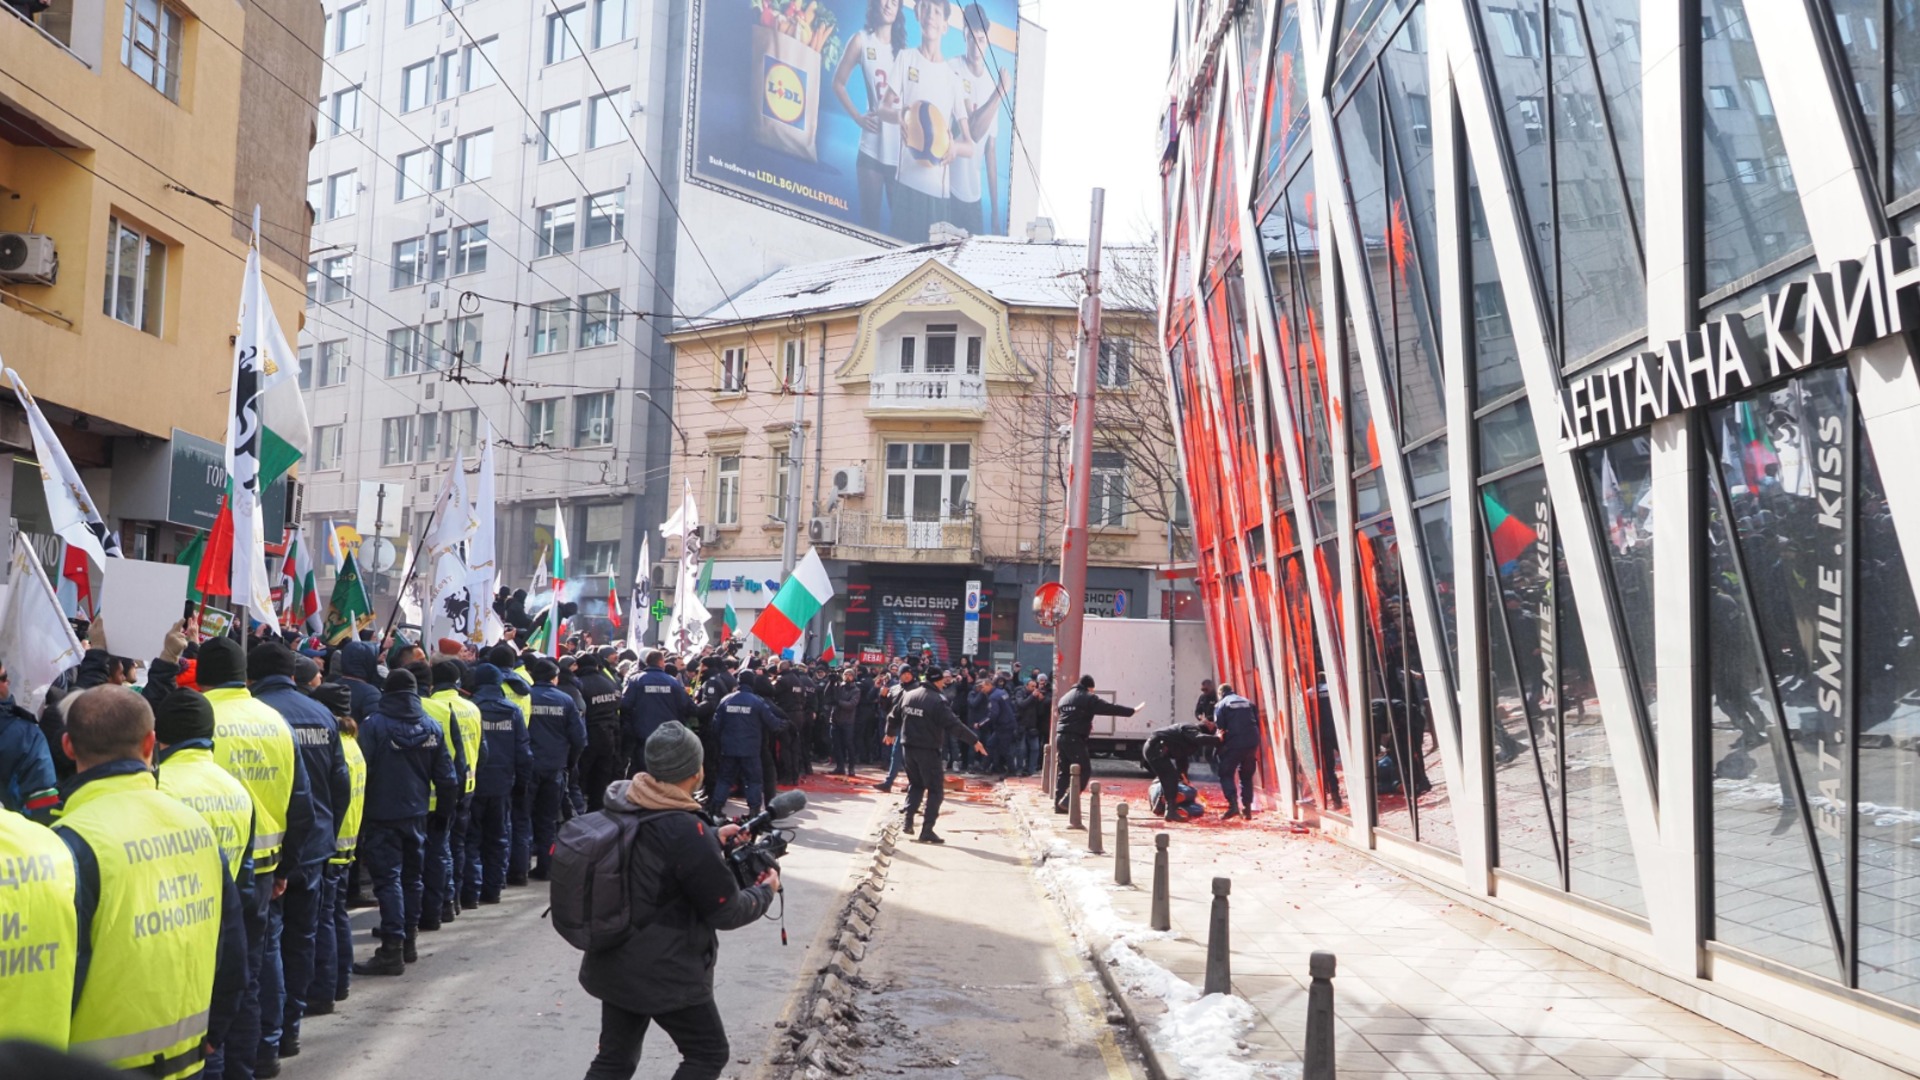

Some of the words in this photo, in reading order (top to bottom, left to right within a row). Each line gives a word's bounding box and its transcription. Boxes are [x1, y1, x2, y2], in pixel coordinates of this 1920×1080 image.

[757, 169, 849, 210] LIDL.BG/VOLLEYBALL
[1556, 314, 1752, 454] ДЕНТАЛНА
[1818, 415, 1842, 529] KISS
[1535, 502, 1551, 578] KISS
[883, 595, 927, 608] CASIO
[928, 597, 959, 609] SHOP
[1540, 602, 1555, 706] SMILE
[1818, 565, 1842, 718] SMILE
[592, 693, 616, 705] POLICE
[1818, 739, 1841, 840] EAT
[123, 827, 213, 865] ПОЛИЦИЯ
[158, 873, 203, 903] АНТИ-
[134, 897, 215, 939] КОНФЛИКТ
